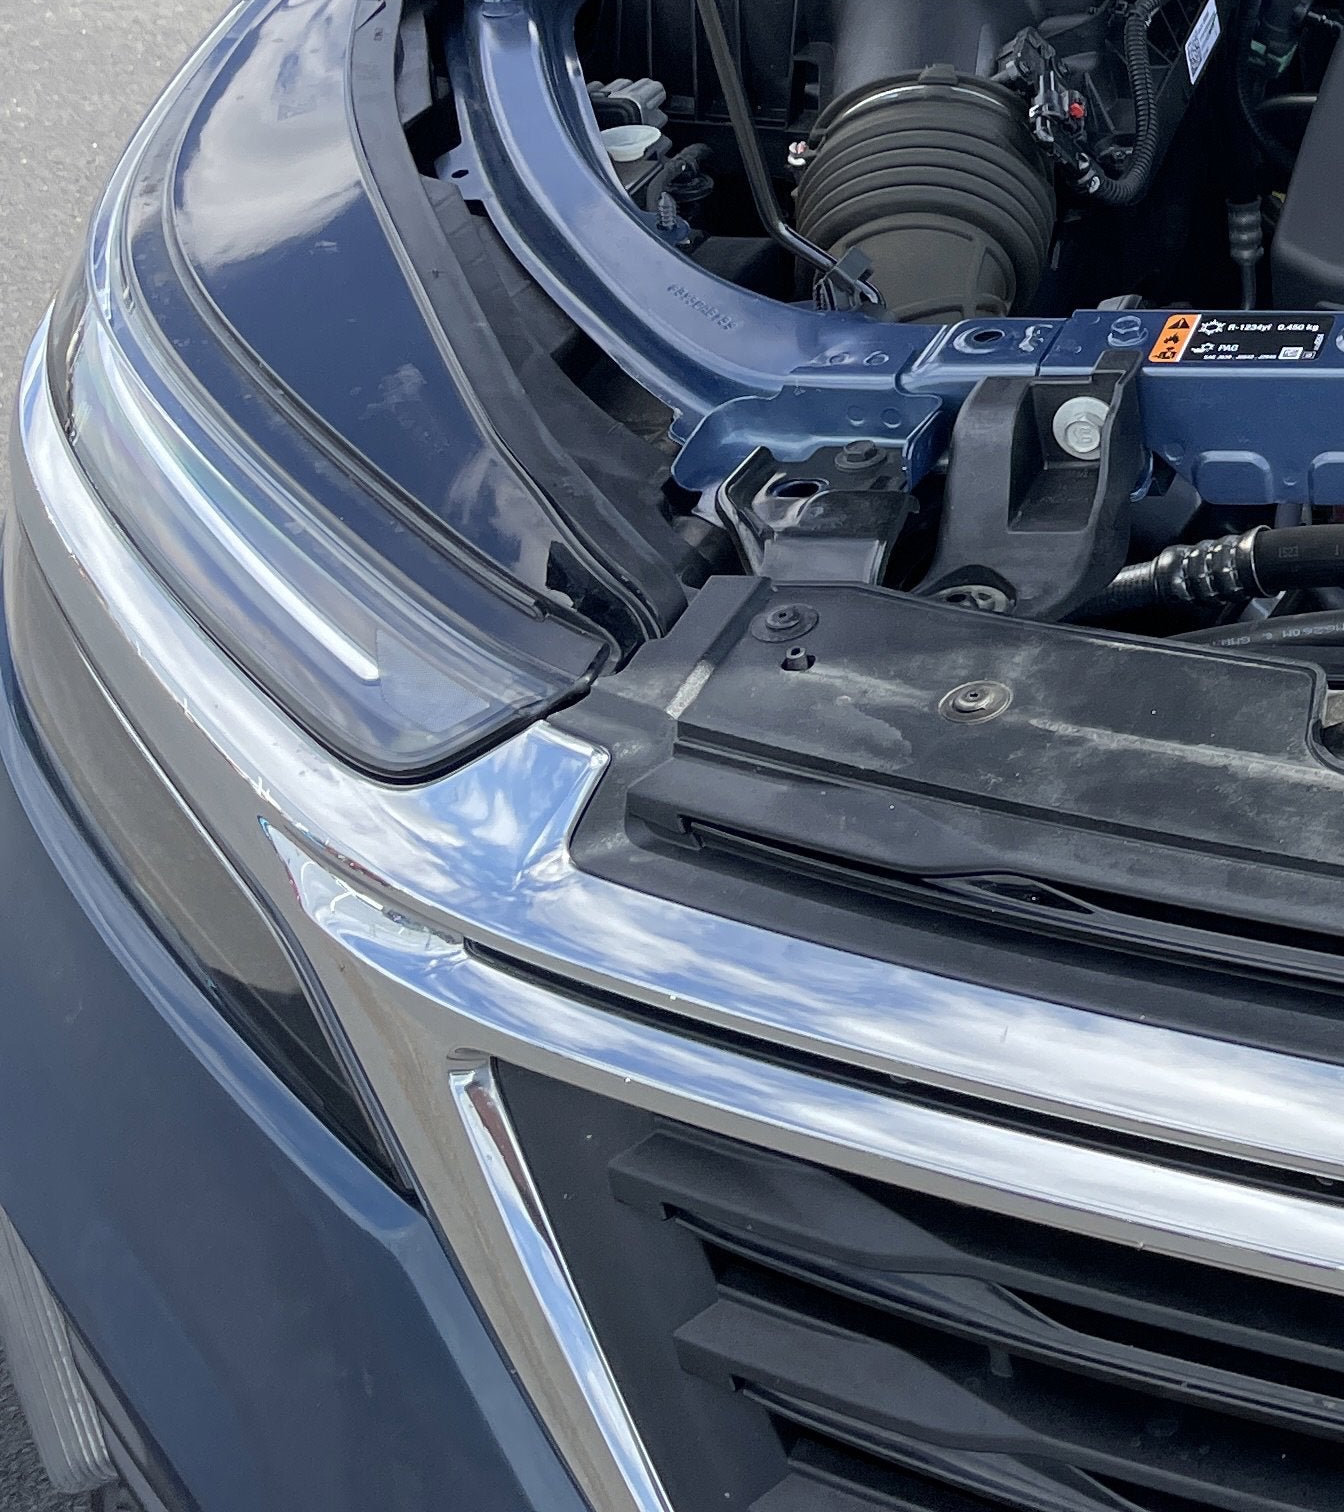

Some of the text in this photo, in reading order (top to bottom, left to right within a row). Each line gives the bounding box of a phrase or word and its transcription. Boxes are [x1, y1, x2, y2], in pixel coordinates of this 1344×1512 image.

[1227, 323, 1272, 332] R-1234yf
[1305, 323, 1319, 332] kg
[1217, 344, 1239, 352] PAG
